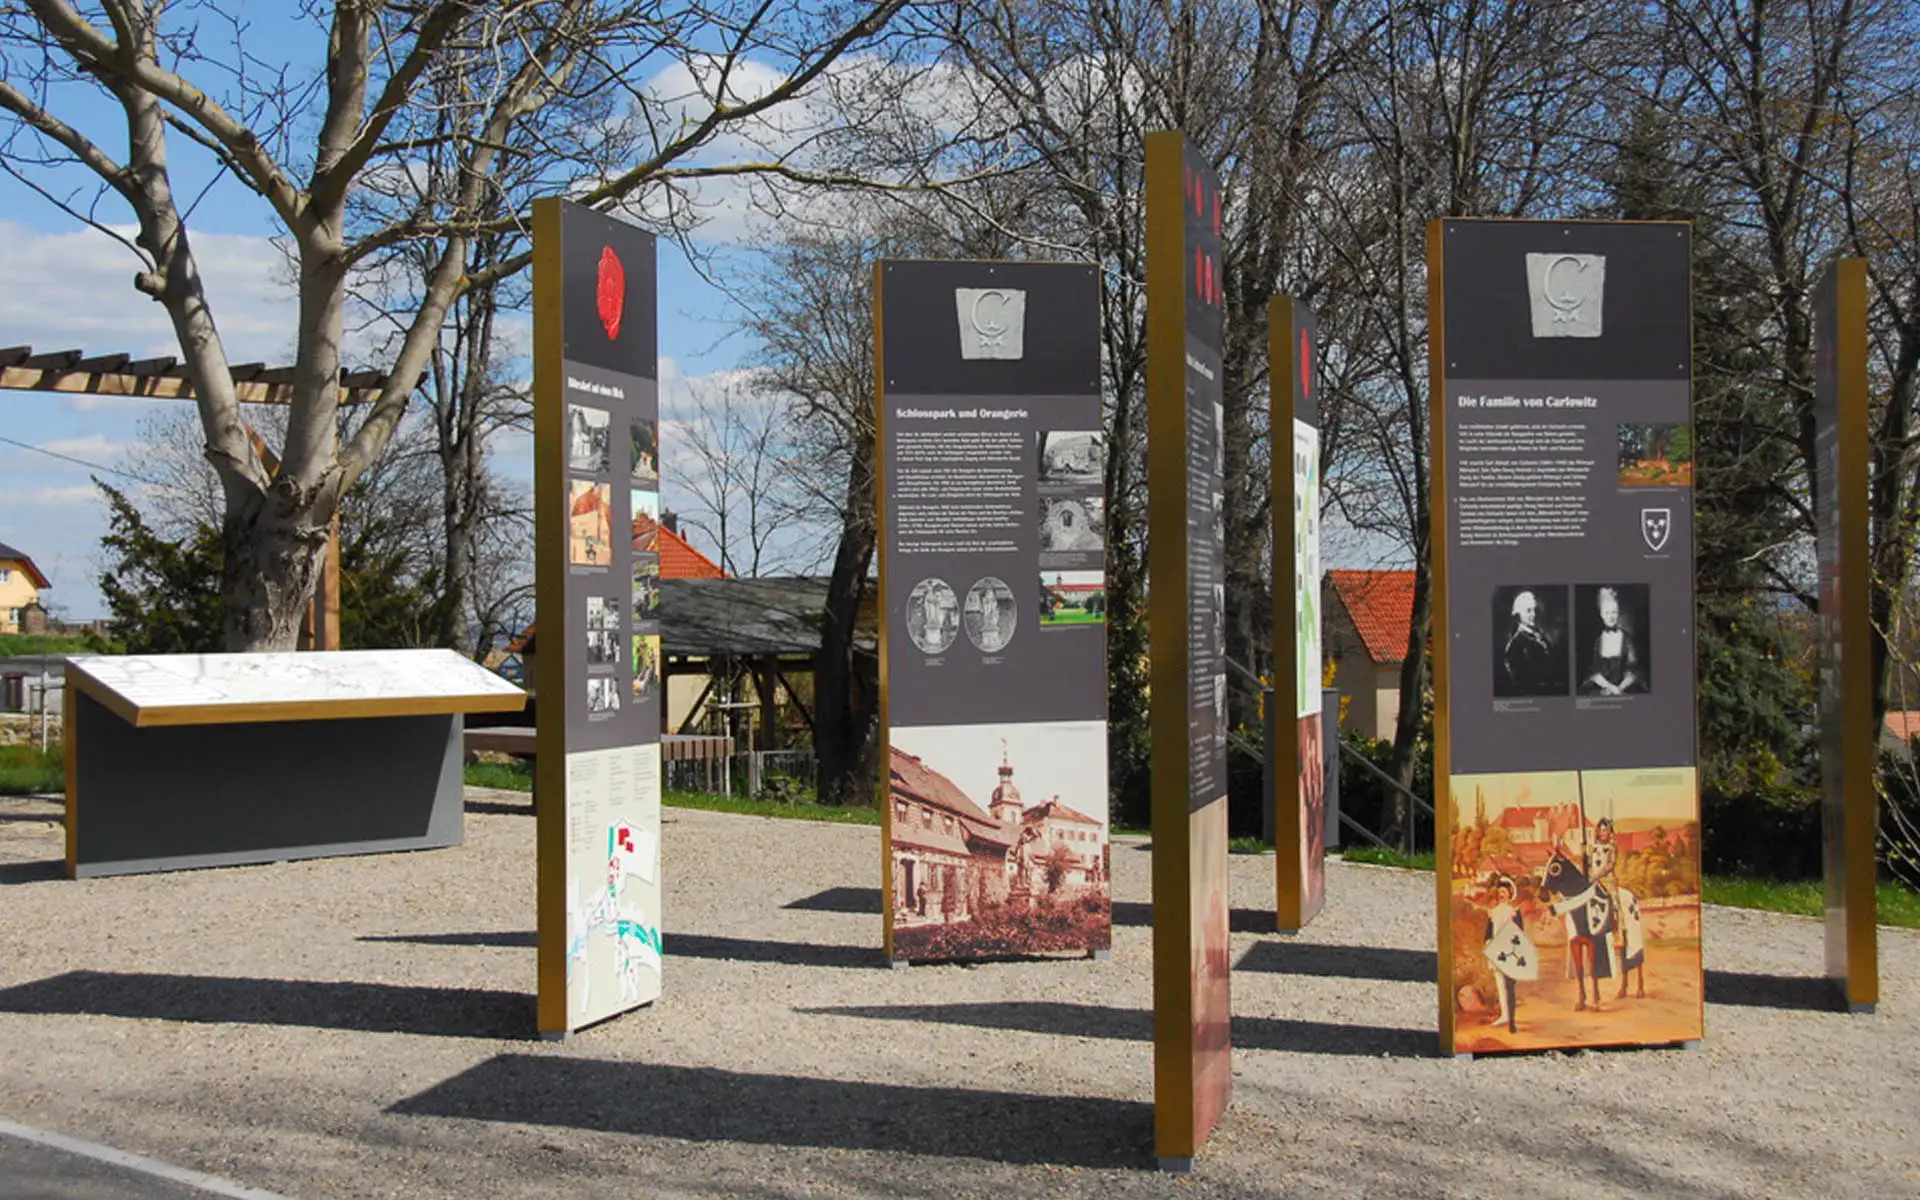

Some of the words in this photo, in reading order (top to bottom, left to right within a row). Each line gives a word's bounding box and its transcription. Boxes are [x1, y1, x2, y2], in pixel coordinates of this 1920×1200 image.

[1458, 395, 1477, 408] Die
[1479, 395, 1521, 408] Familie
[1523, 397, 1544, 408] von
[1545, 395, 1597, 408] Carlowitz
[896, 408, 956, 420] Schlosspark
[958, 408, 978, 418] und
[979, 408, 1028, 420] Orangerie
